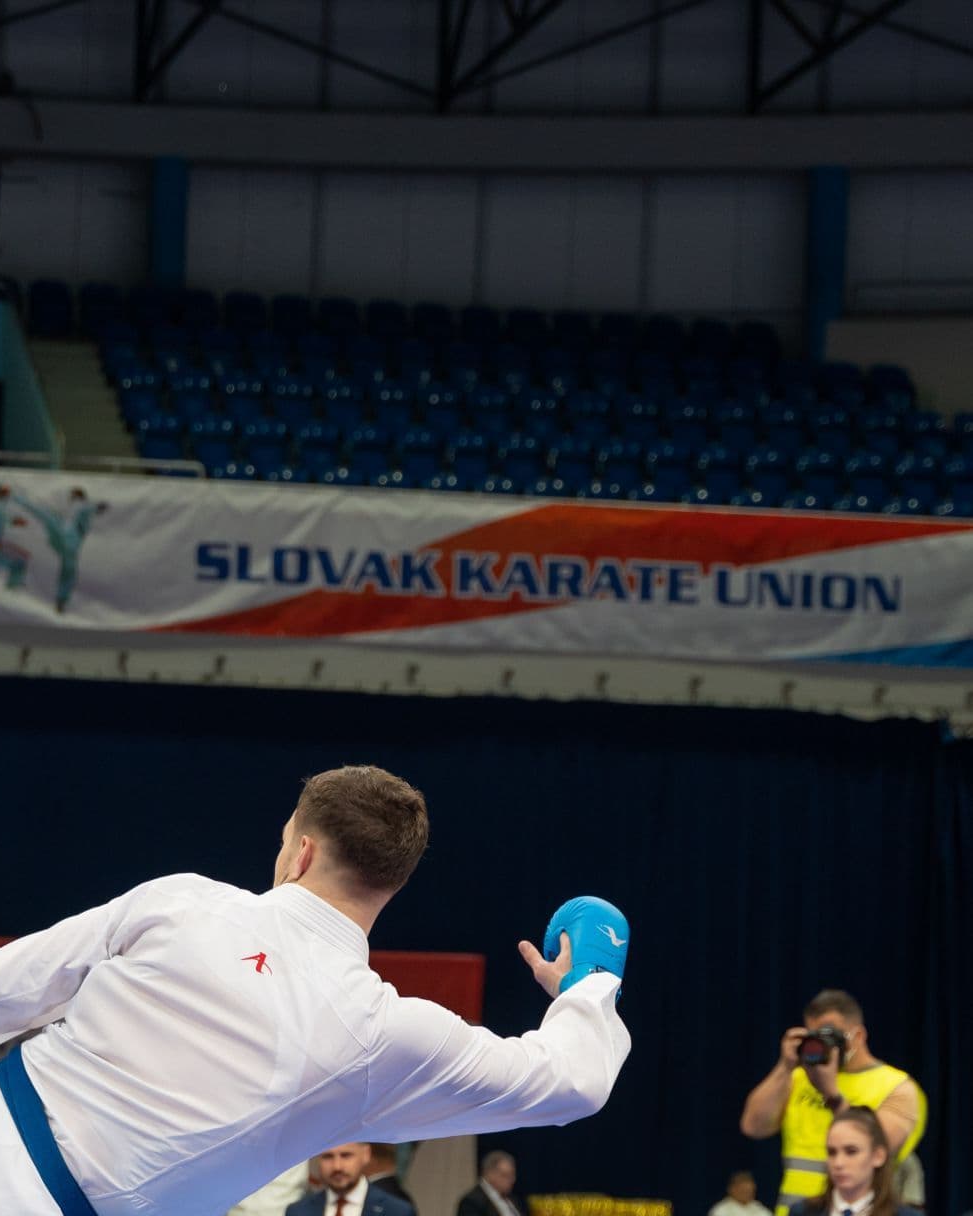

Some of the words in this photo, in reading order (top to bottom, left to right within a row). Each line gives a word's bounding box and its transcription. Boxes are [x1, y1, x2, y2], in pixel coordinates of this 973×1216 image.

[195, 542, 437, 592] SLOVAK
[459, 554, 700, 604] KARATE
[716, 568, 902, 613] UNION
